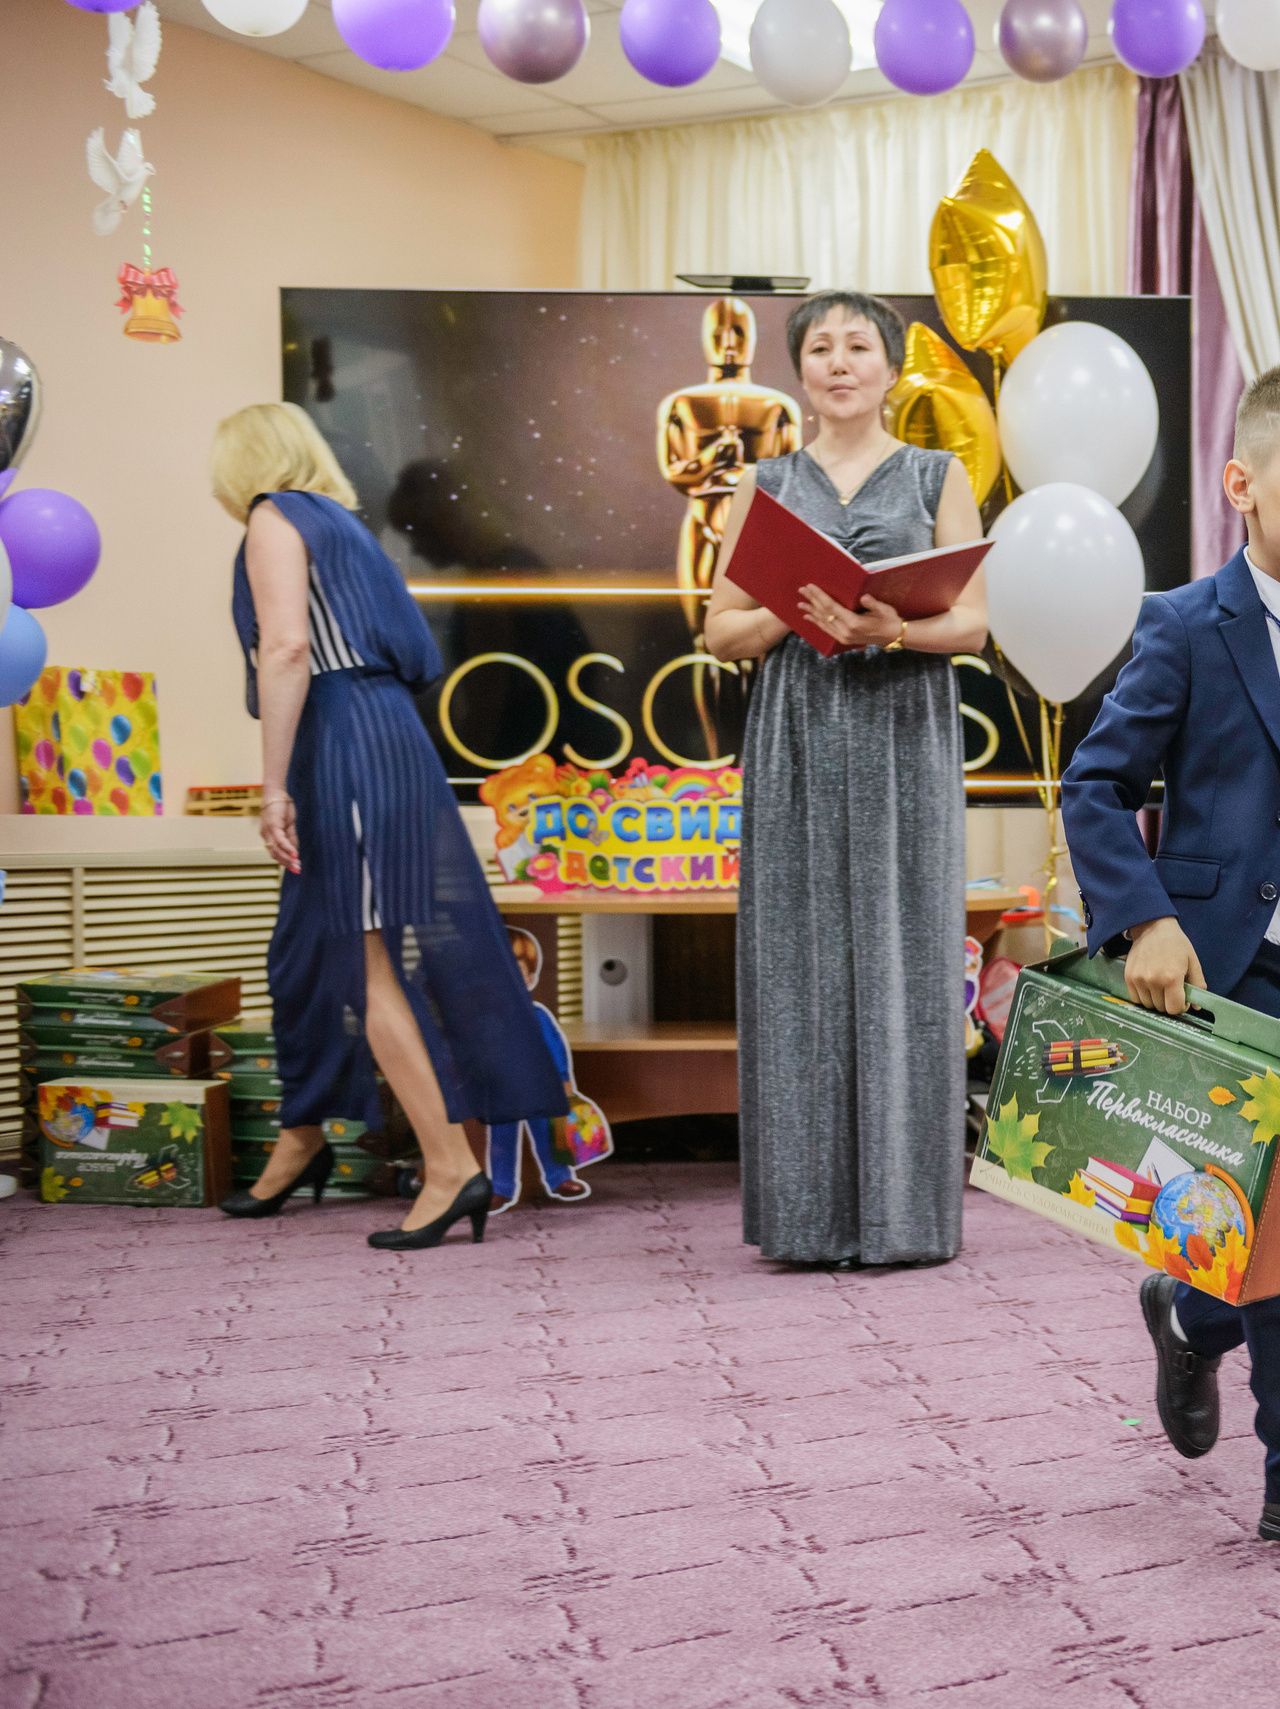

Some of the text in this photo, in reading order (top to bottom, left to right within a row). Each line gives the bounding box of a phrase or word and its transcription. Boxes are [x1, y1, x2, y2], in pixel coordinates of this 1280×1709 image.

[439, 651, 999, 771] OSCS
[533, 802, 599, 844] ДО
[1086, 1080, 1246, 1167] Первоклассника
[1146, 1089, 1211, 1130] НАБОР
[984, 1171, 1022, 1195] УЧИТЕСЬ
